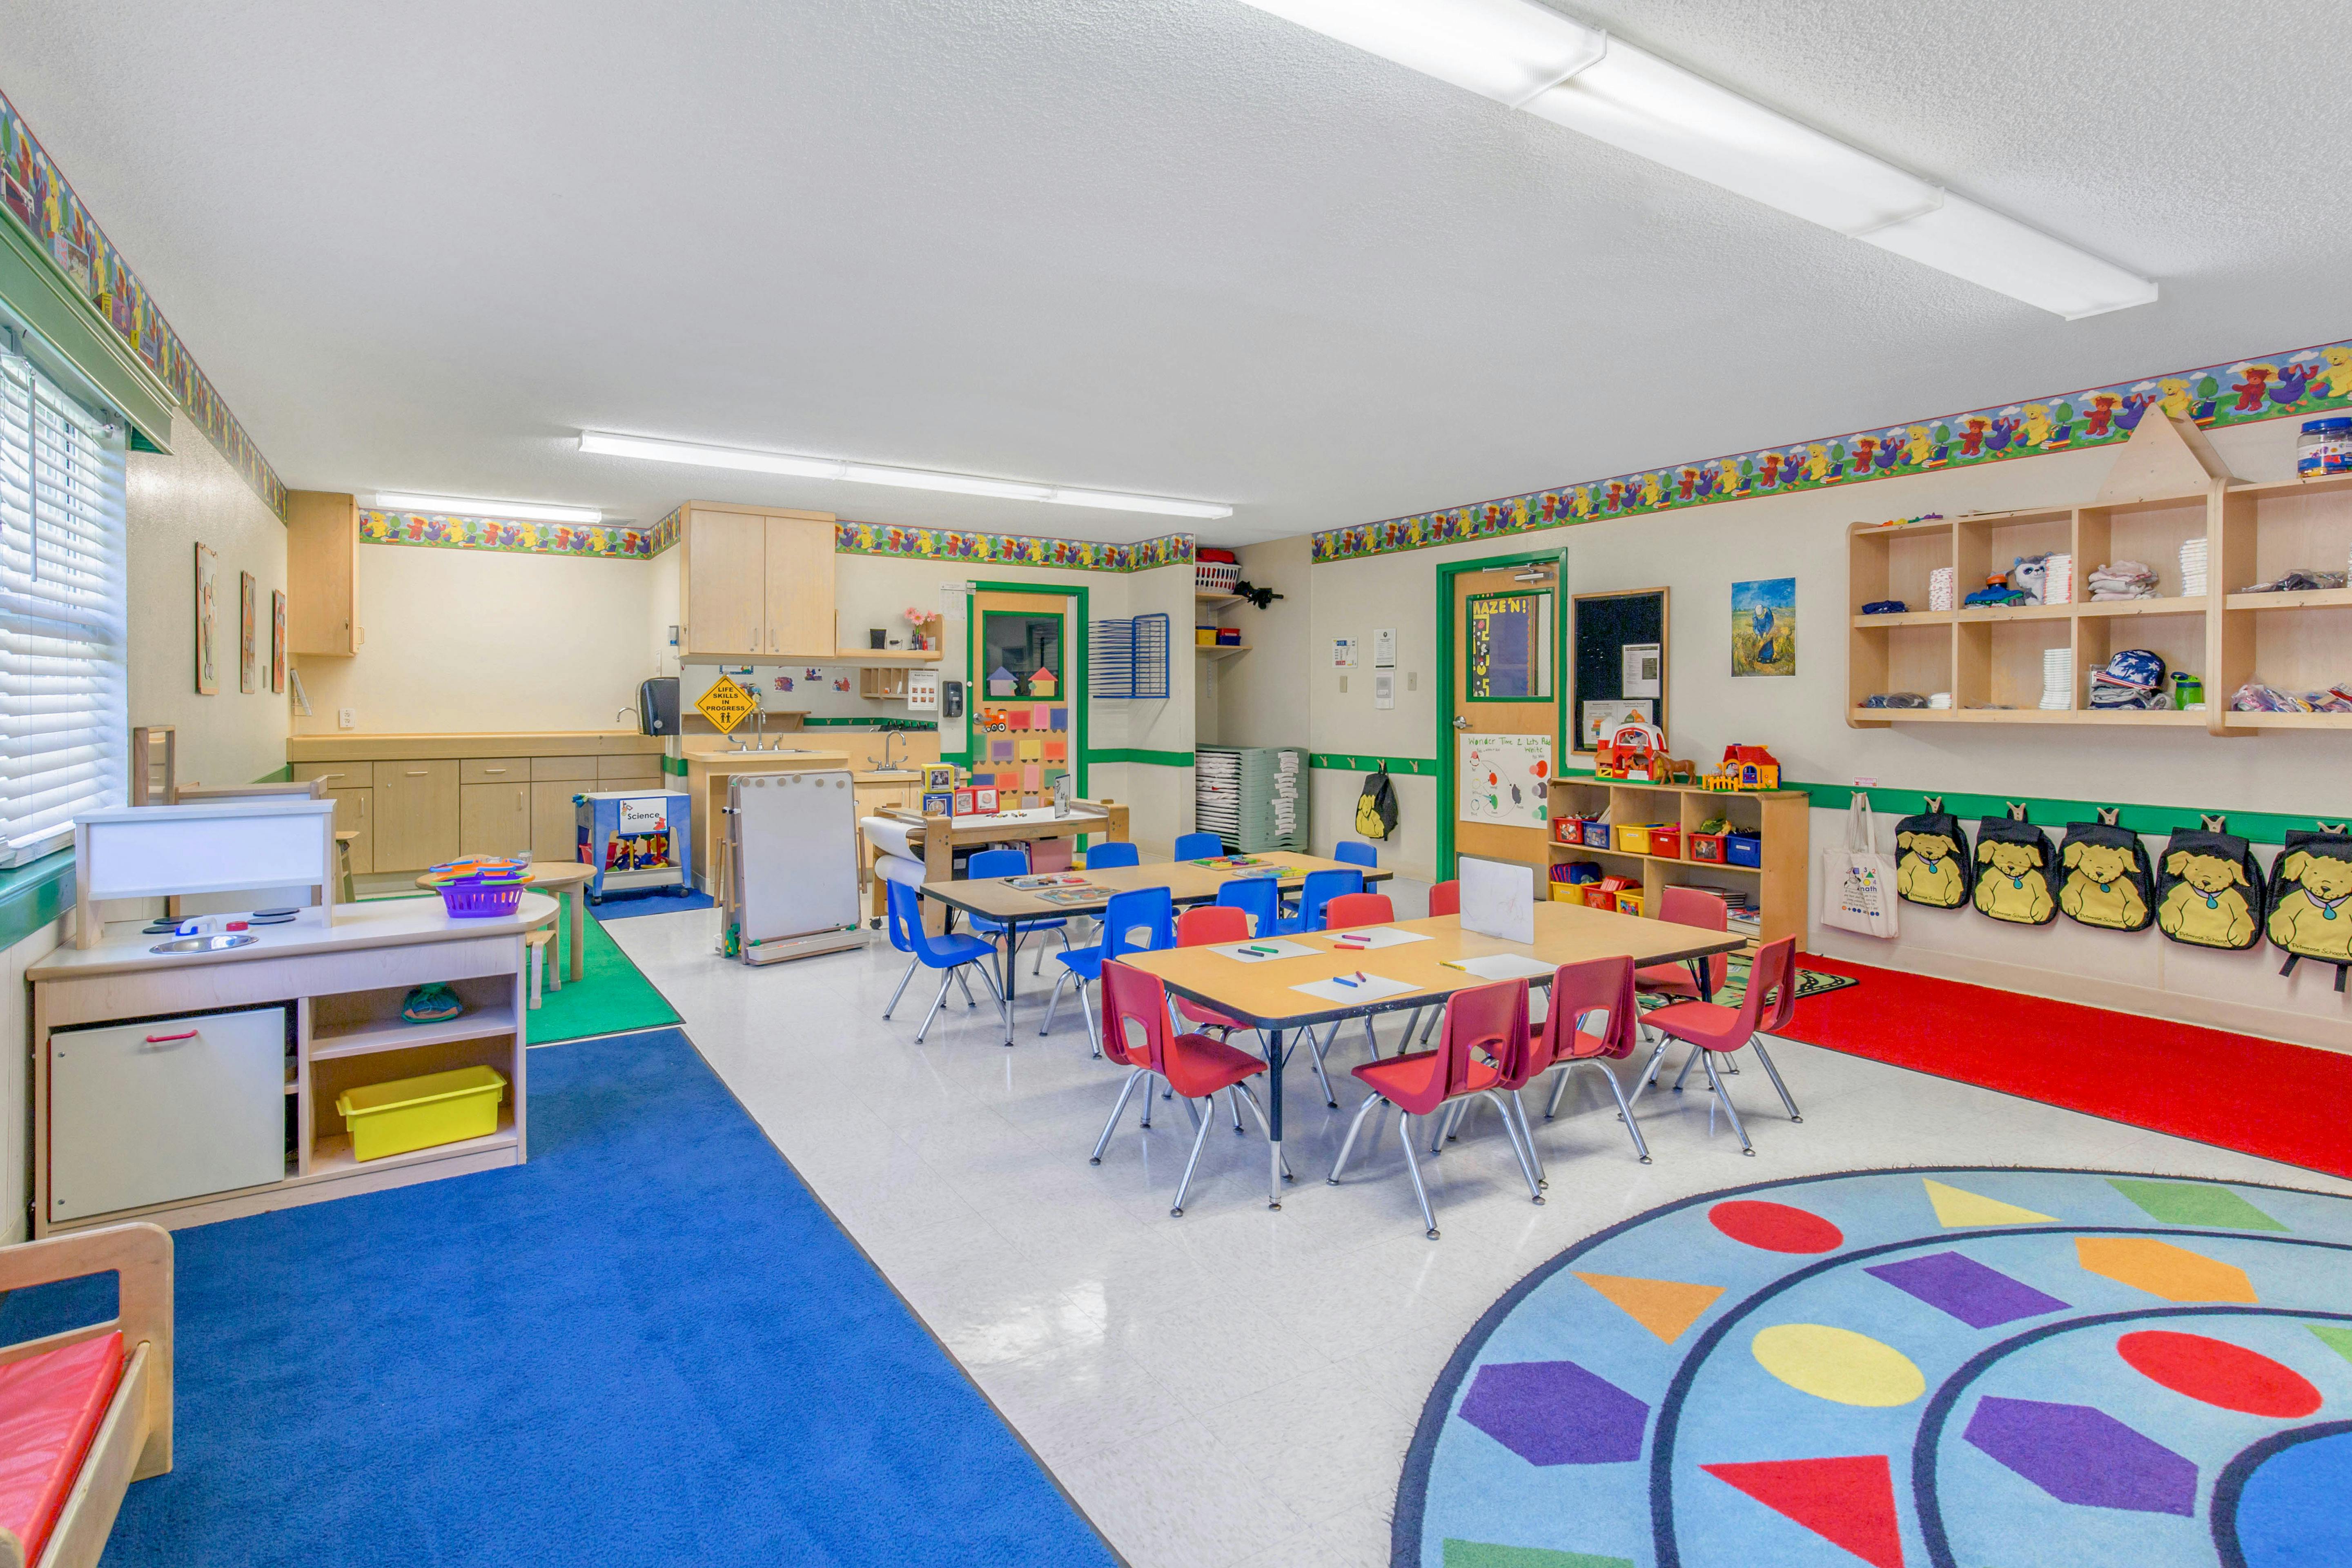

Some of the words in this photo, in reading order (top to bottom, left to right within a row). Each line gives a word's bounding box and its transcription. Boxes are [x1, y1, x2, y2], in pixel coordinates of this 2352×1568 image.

[1468, 737, 1496, 746] Wonder
[1541, 737, 1551, 746] Add
[2179, 931, 2204, 940] Primrose
[2291, 943, 2320, 952] Primrose
